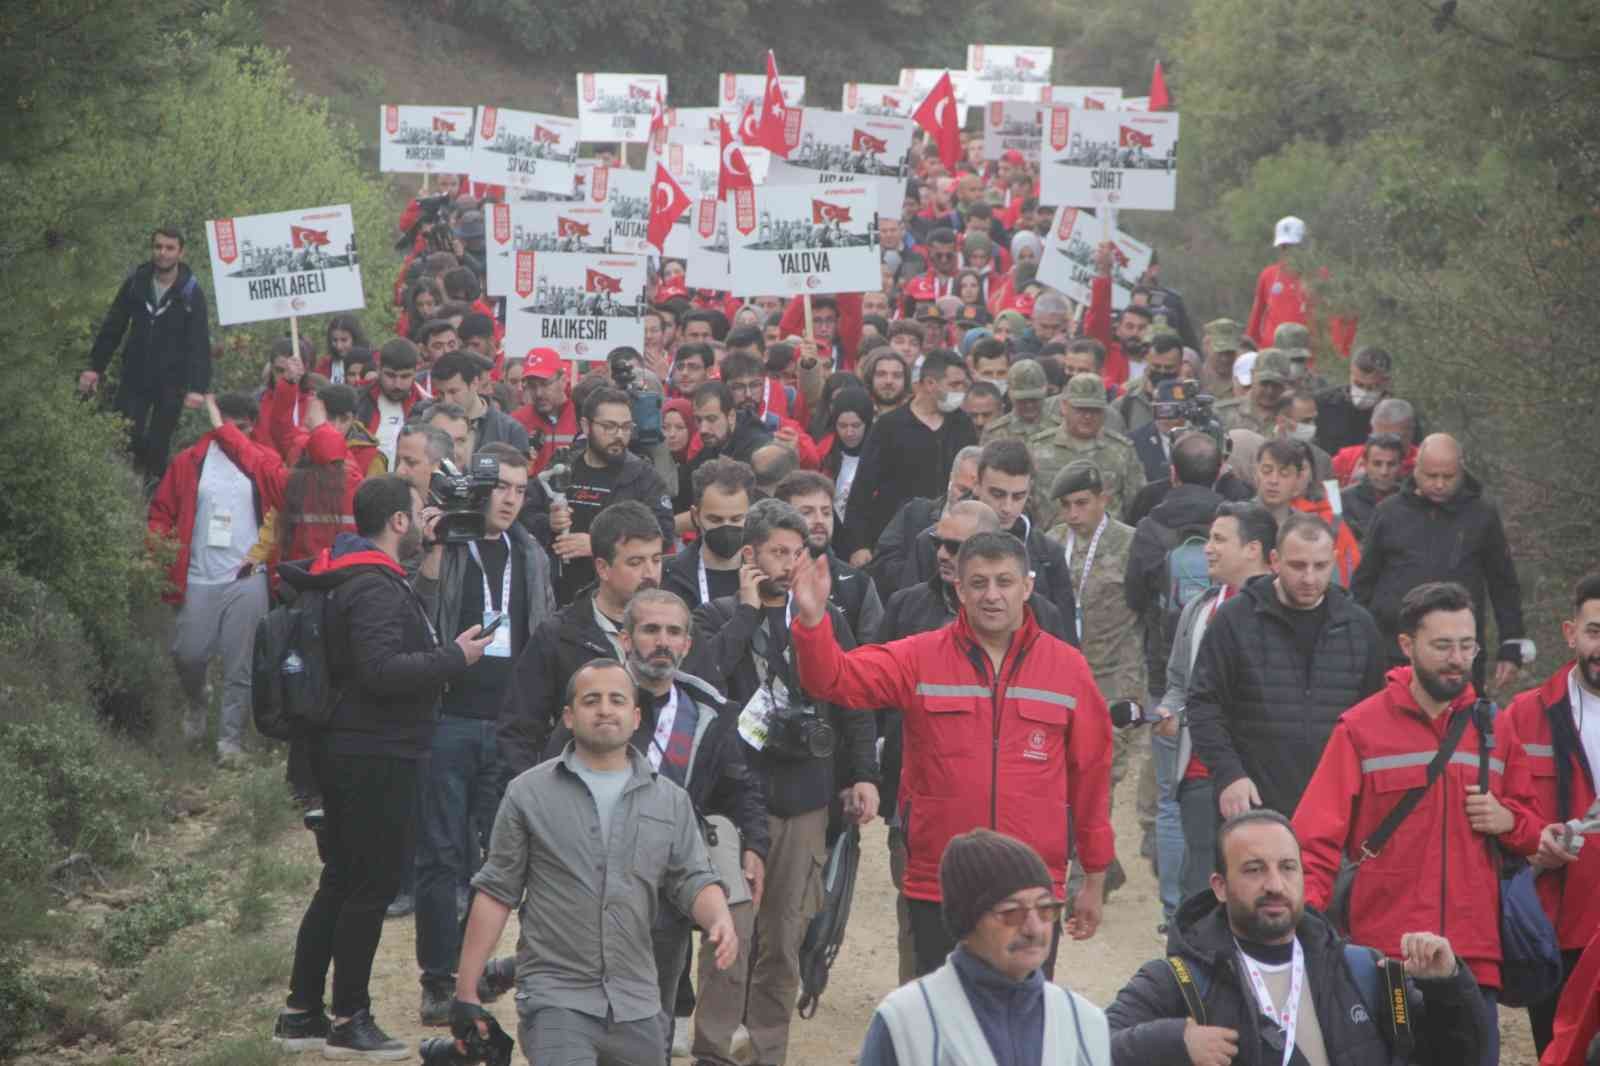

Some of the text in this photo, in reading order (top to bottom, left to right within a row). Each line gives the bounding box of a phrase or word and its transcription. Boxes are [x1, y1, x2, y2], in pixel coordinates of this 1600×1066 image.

[778, 251, 831, 274] YALOVA
[248, 270, 327, 300] KIRKLARELİ
[541, 318, 608, 340] BALIKESİR
